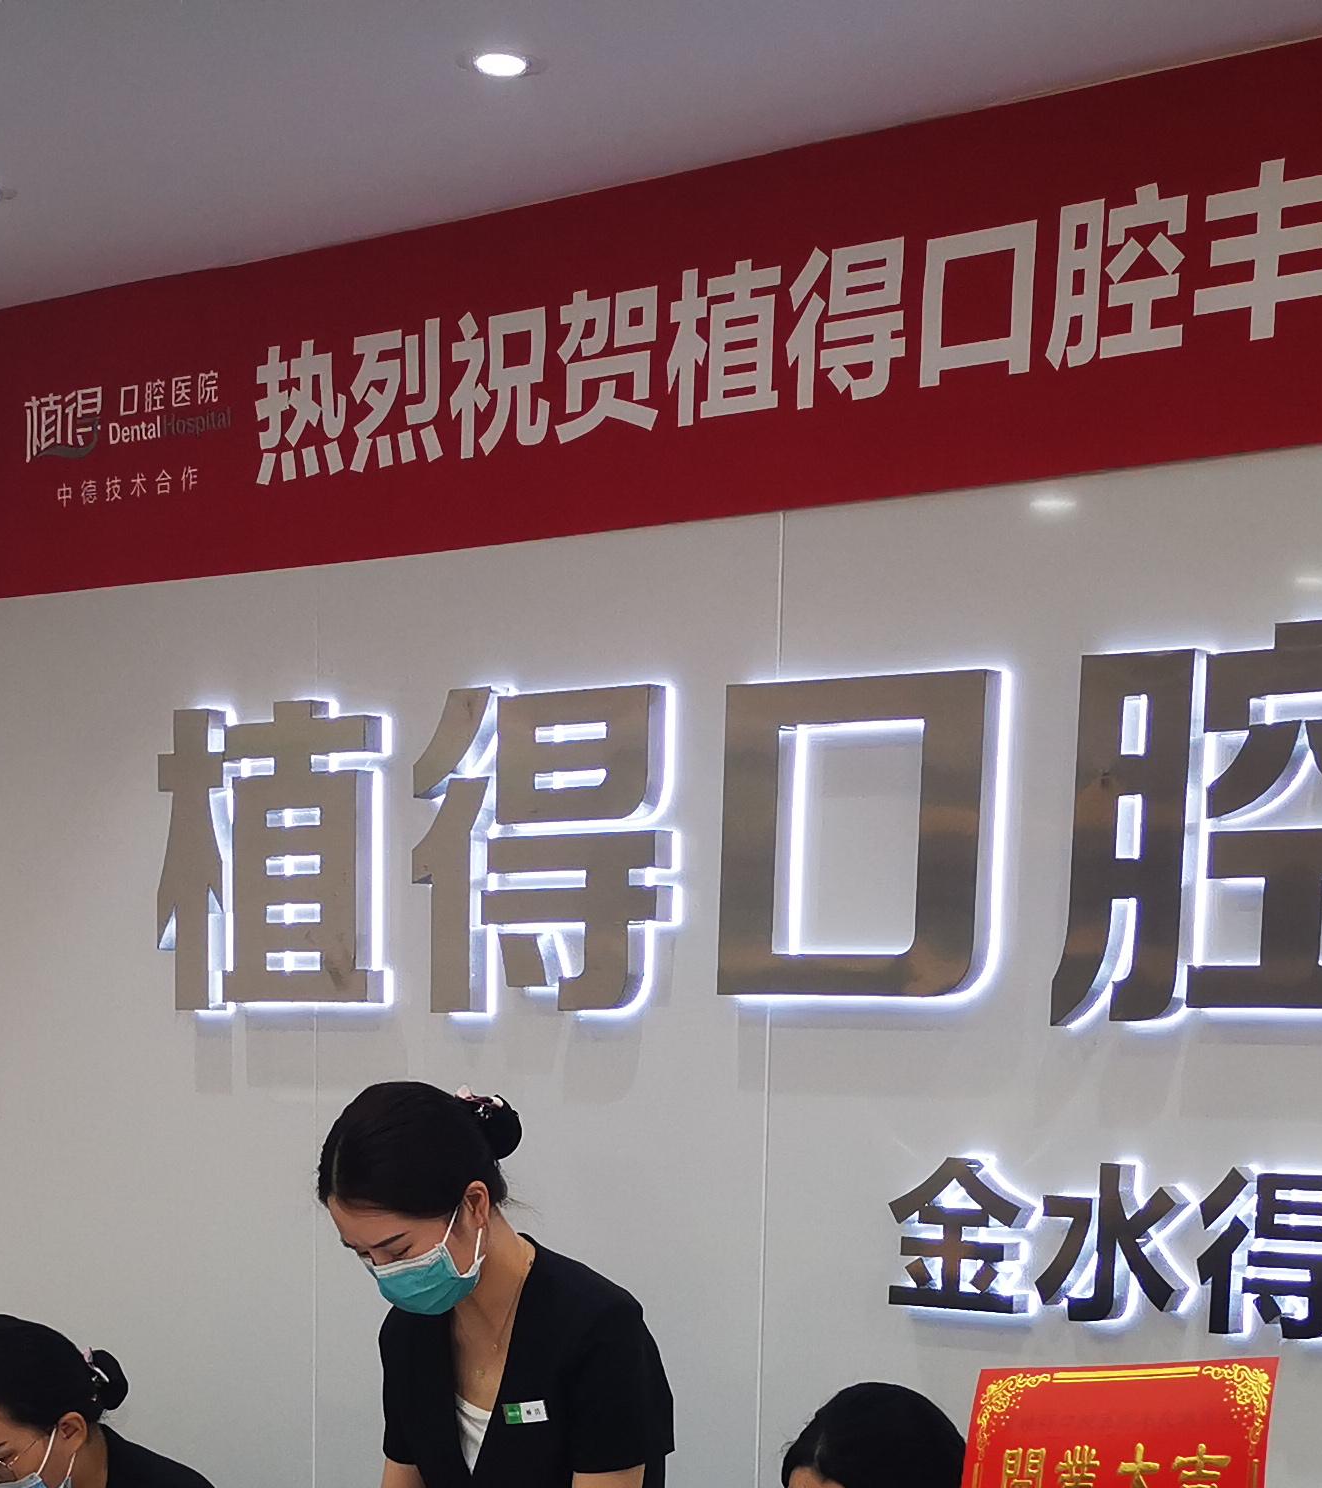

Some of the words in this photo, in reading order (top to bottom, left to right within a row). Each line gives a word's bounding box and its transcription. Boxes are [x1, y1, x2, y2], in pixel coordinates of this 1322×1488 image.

[120, 369, 219, 417] 口腔医院
[24, 385, 103, 464] 植得
[108, 415, 161, 445] Dental
[57, 465, 199, 508] 中德技术合作
